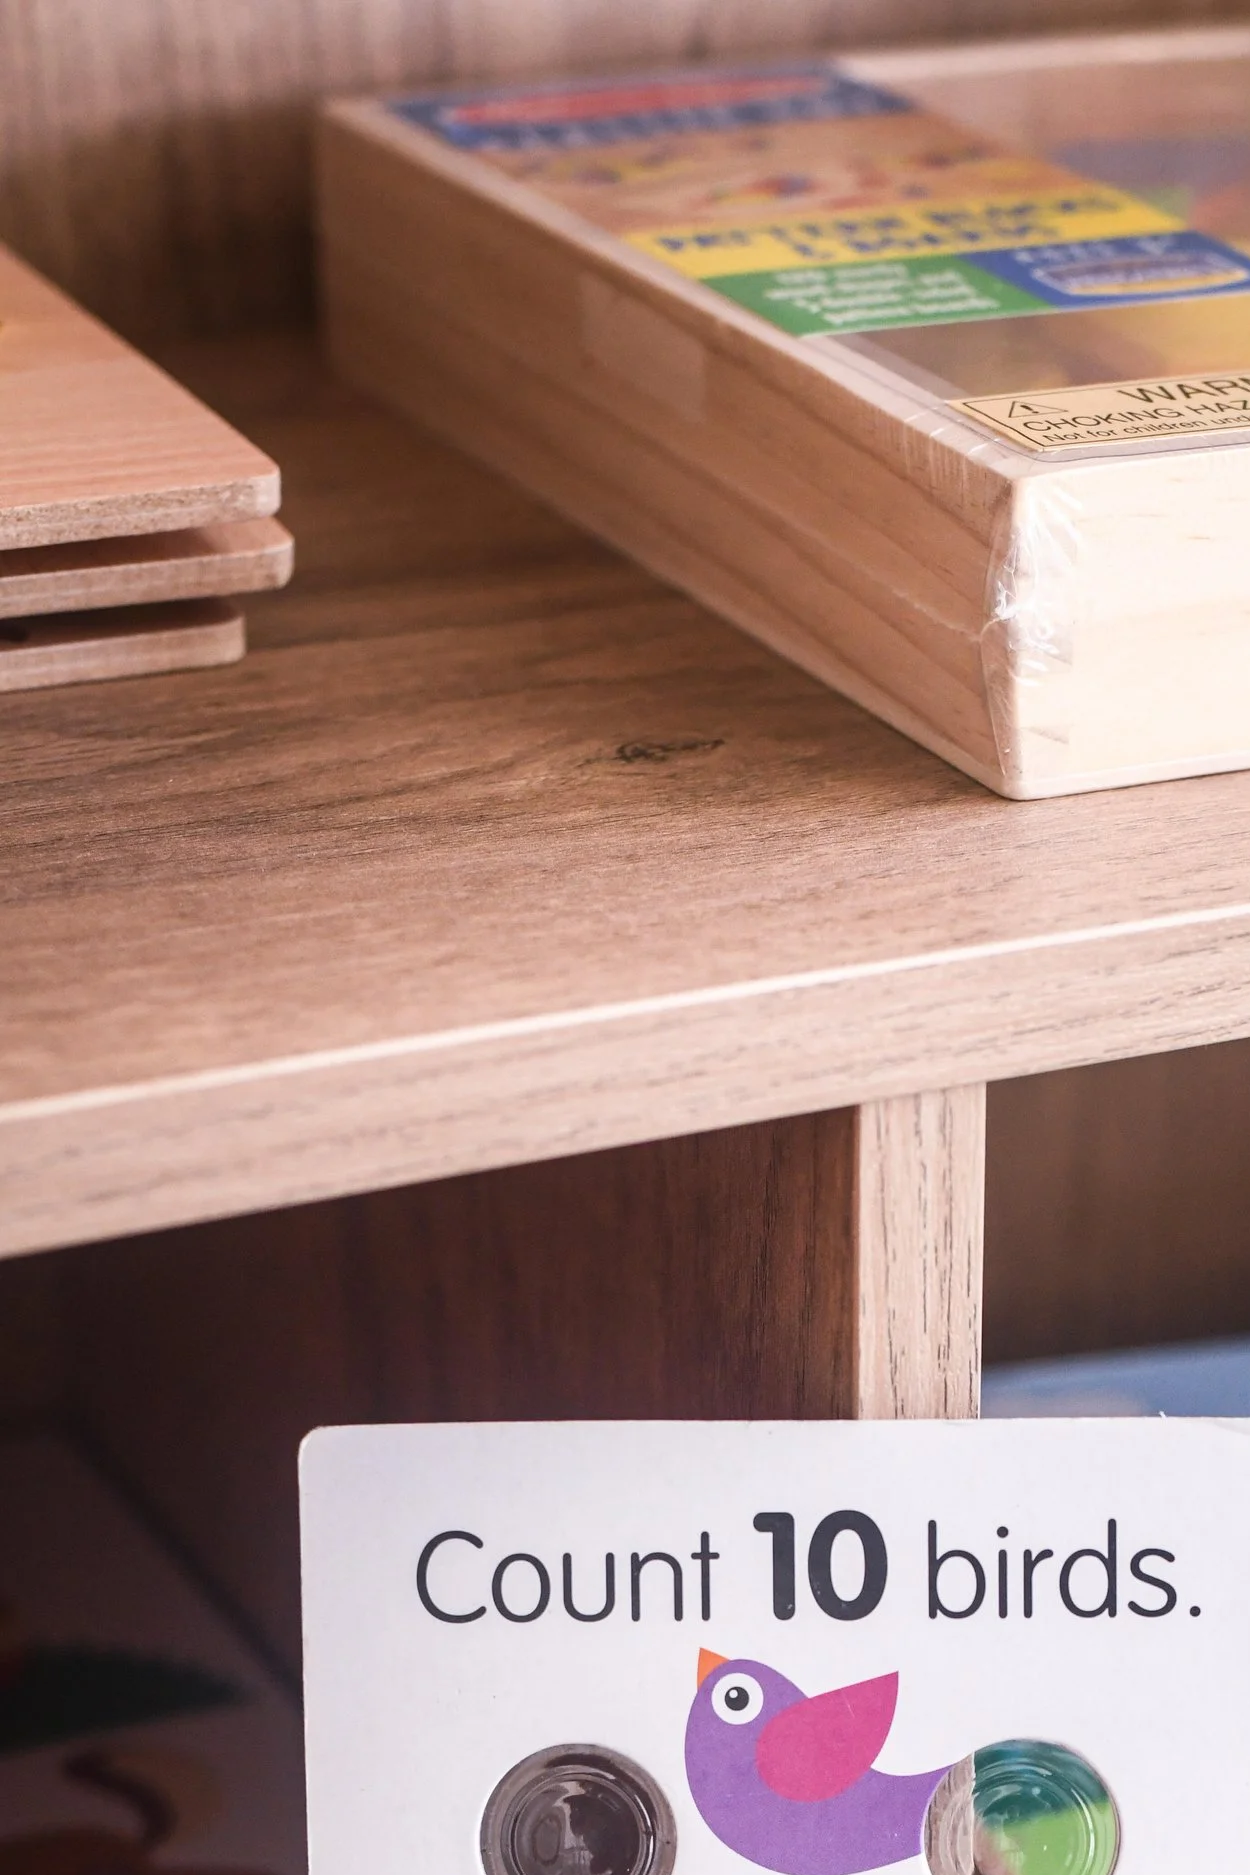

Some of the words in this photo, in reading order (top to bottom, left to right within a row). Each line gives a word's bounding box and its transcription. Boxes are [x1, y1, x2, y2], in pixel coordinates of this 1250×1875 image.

[1022, 407, 1185, 432] CHOKING
[1042, 429, 1083, 442] Not
[1086, 428, 1119, 439] for
[1122, 419, 1208, 435] children
[416, 1529, 720, 1624] Count
[752, 1509, 889, 1622] 10
[928, 1518, 1202, 1621] birds.
